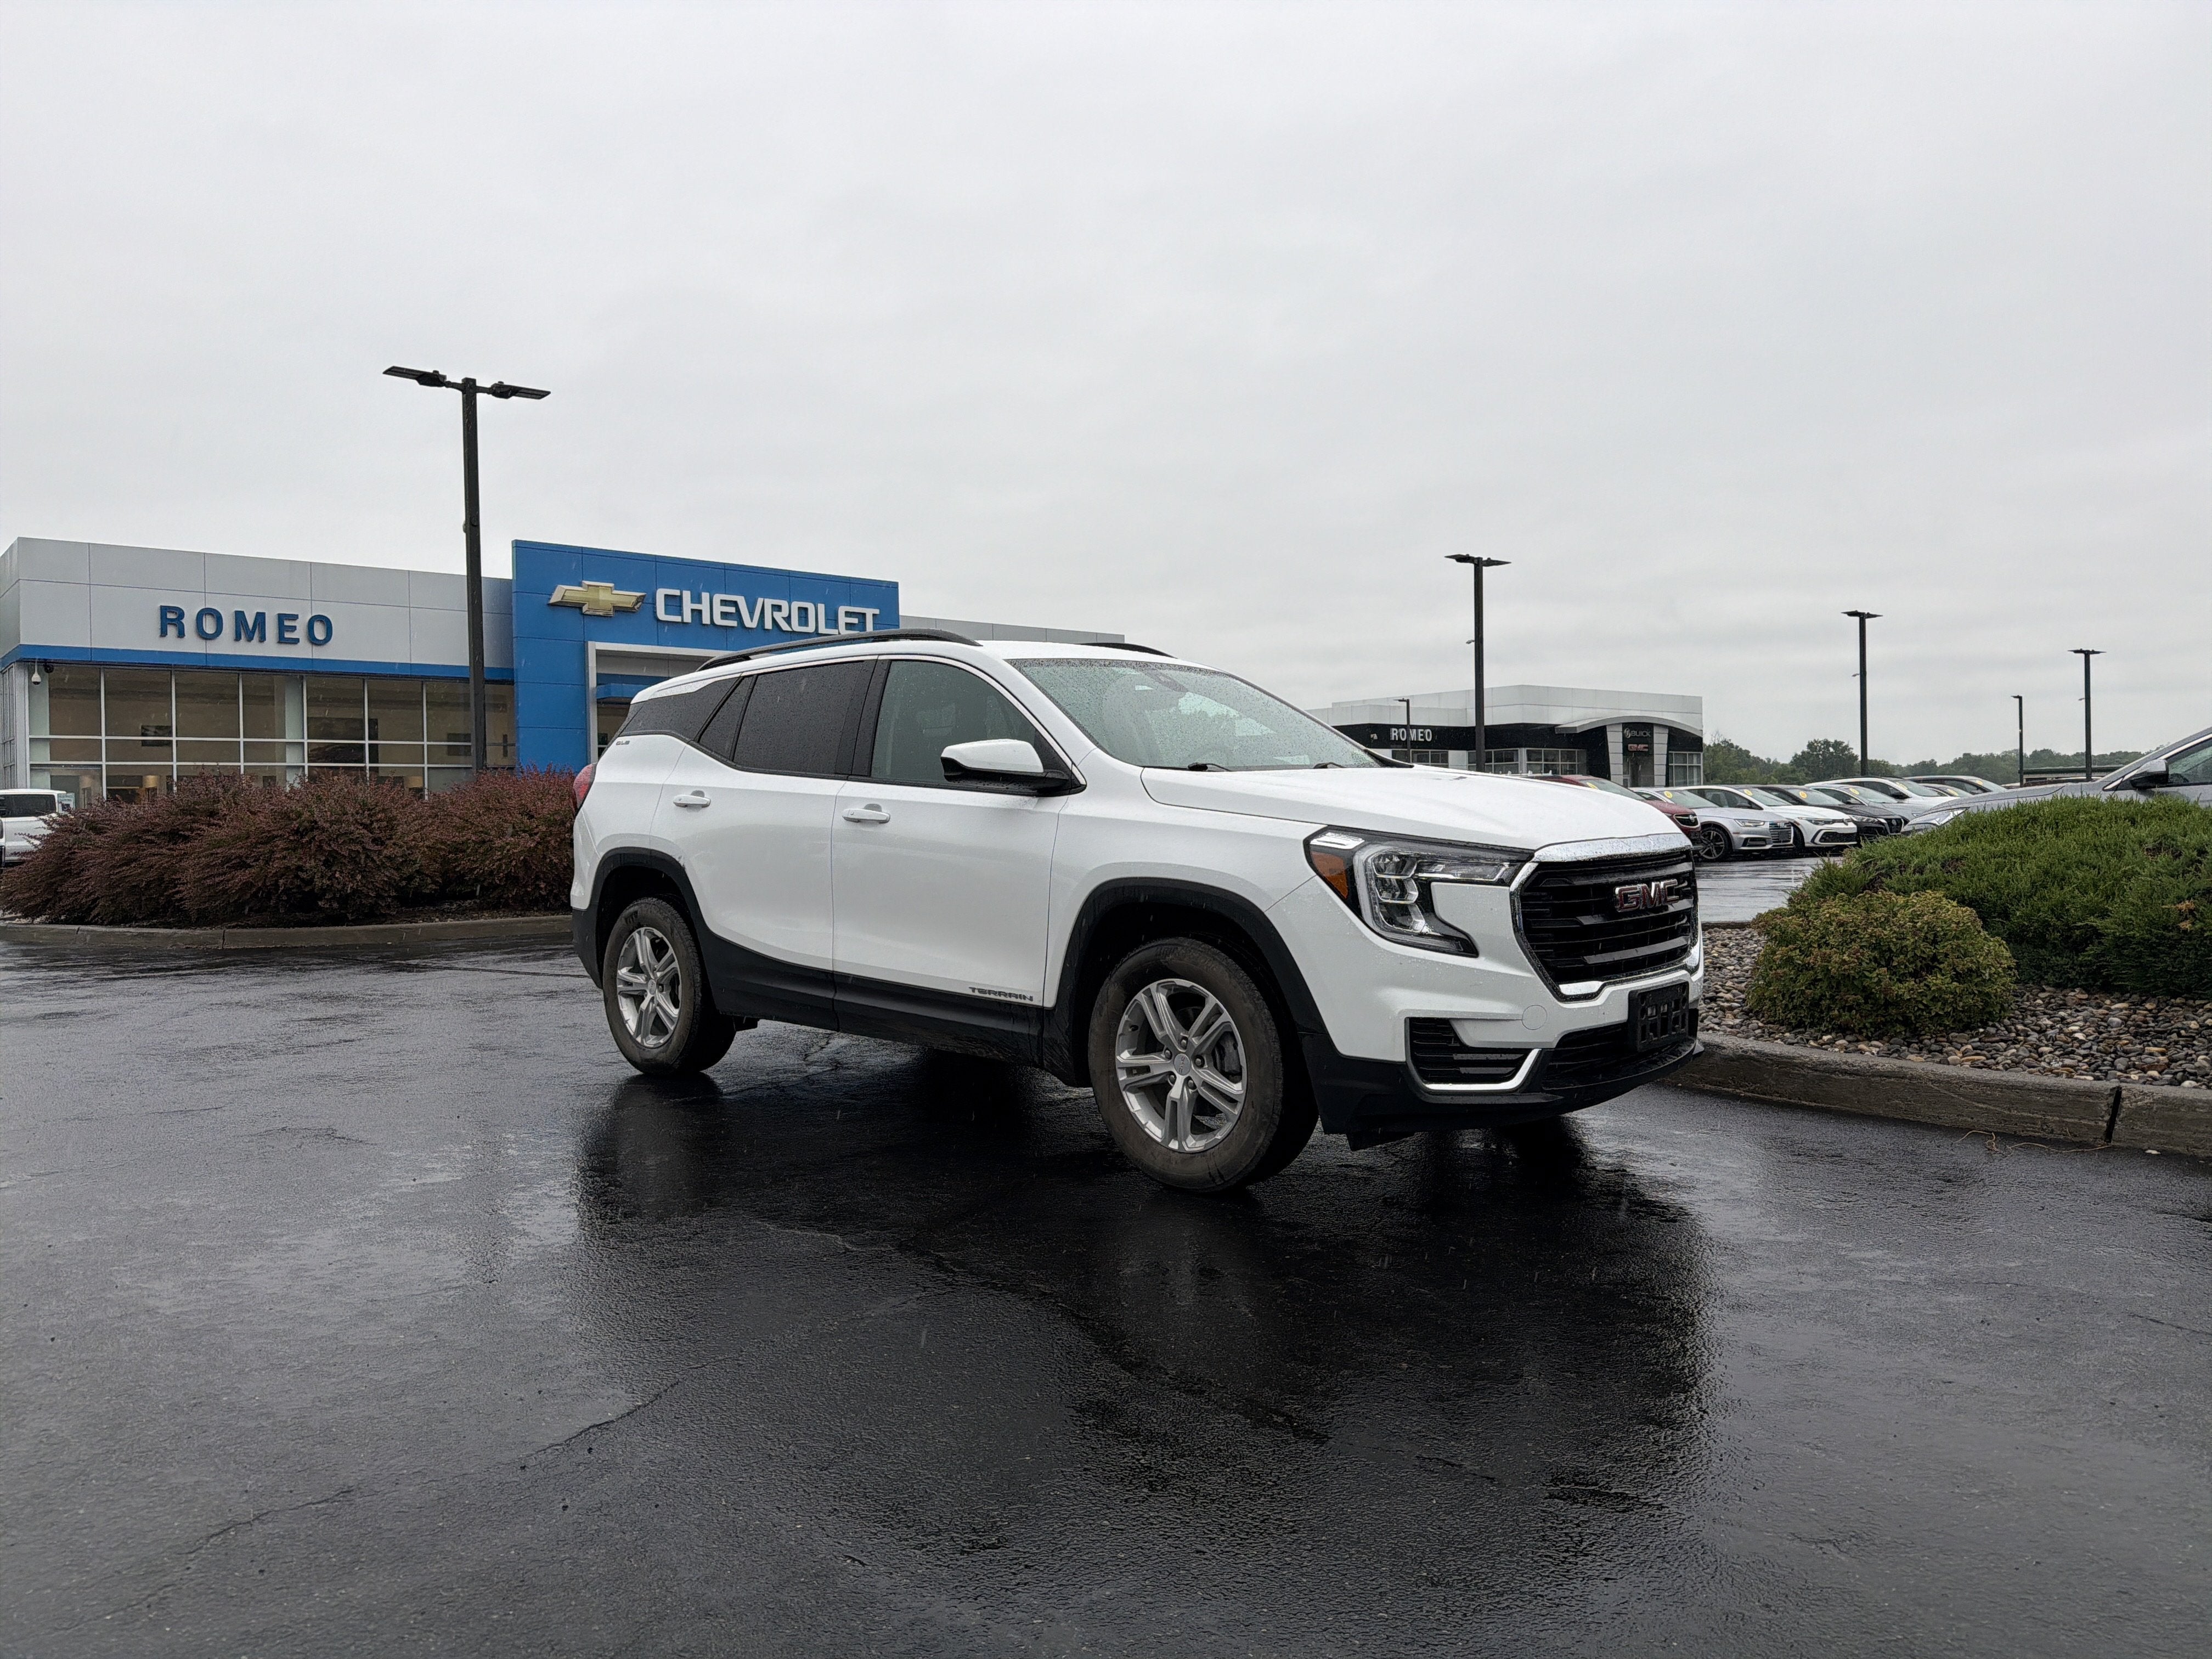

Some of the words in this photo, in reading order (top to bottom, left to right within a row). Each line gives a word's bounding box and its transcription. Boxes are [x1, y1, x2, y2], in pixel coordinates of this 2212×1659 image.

[656, 588, 880, 635] CHEVROLET
[159, 605, 333, 646] ROMEO
[1390, 727, 1432, 742] ROMEO
[1628, 743, 1649, 752] GMC
[1615, 879, 1679, 912] GMC
[968, 986, 1034, 1002] TERRAIN
